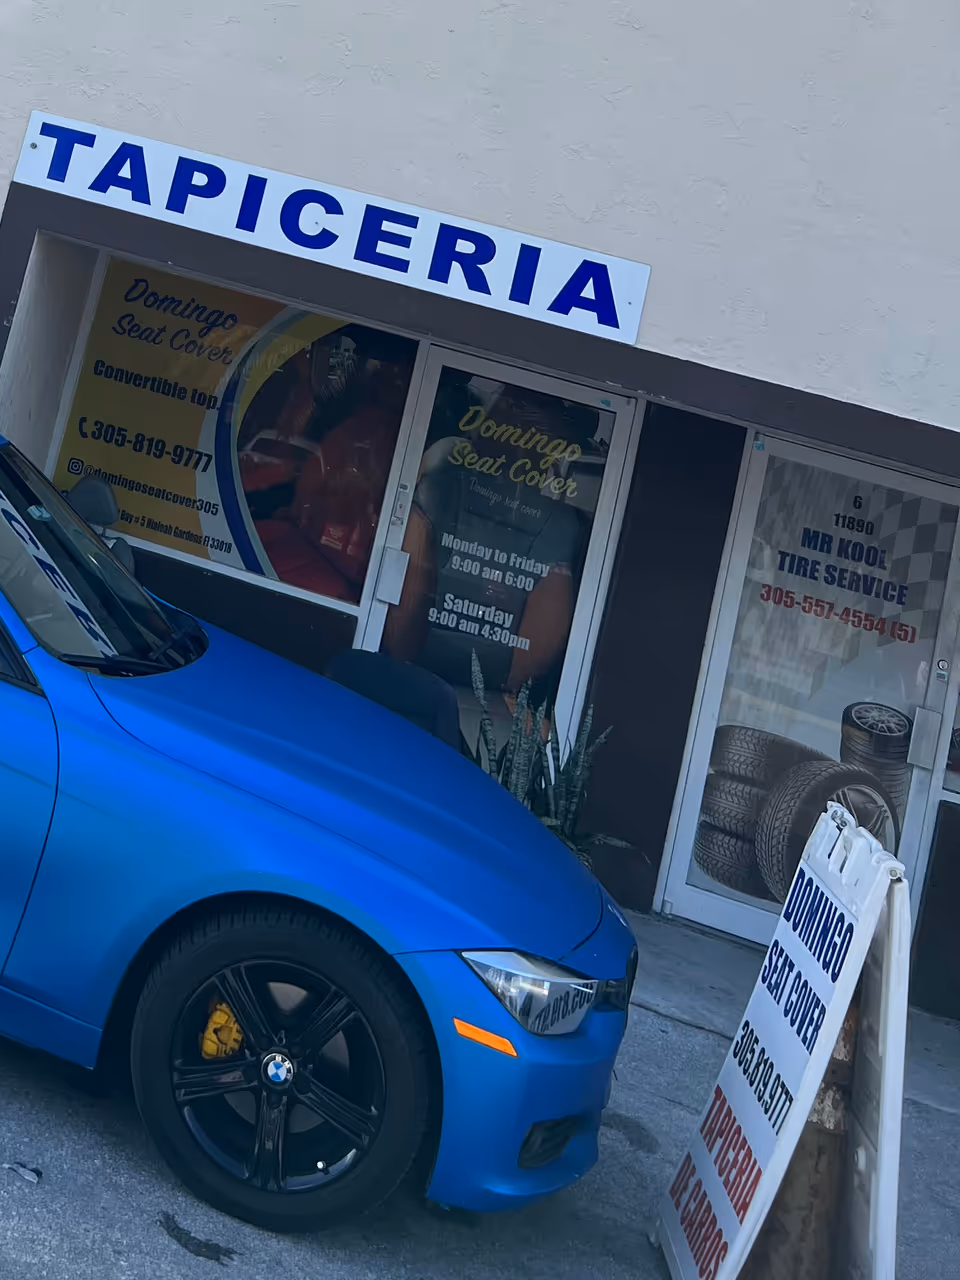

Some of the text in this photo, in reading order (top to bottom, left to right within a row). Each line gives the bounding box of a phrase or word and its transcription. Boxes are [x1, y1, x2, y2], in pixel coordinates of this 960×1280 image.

[39, 121, 622, 330] TAPICERIA
[124, 278, 239, 337] Domingo
[112, 313, 234, 366] Seat Cover
[93, 359, 188, 401] Convertible
[91, 419, 213, 474] 305-819-9777
[458, 405, 582, 470] Domingo
[447, 439, 578, 498] Seat Cover
[833, 512, 875, 536] 11890
[852, 495, 863, 510] 6
[210, 537, 233, 554] 33018
[441, 532, 551, 578] Monday to Friday
[800, 527, 888, 571] MR KOOL
[451, 556, 535, 592] 9:00 am 6:00
[777, 550, 909, 606] TIRE SERVICE
[428, 607, 531, 652] 9:00 am 4:30pm
[442, 593, 514, 628] Saturday
[759, 583, 887, 636] 305-557-4554
[781, 867, 855, 984] DOMINGO
[761, 938, 828, 1056] SEAT COVER
[732, 1019, 794, 1136] 305.819.9777
[699, 1084, 763, 1226] TAPICERIA
[669, 1151, 729, 1280] DE CARROS
